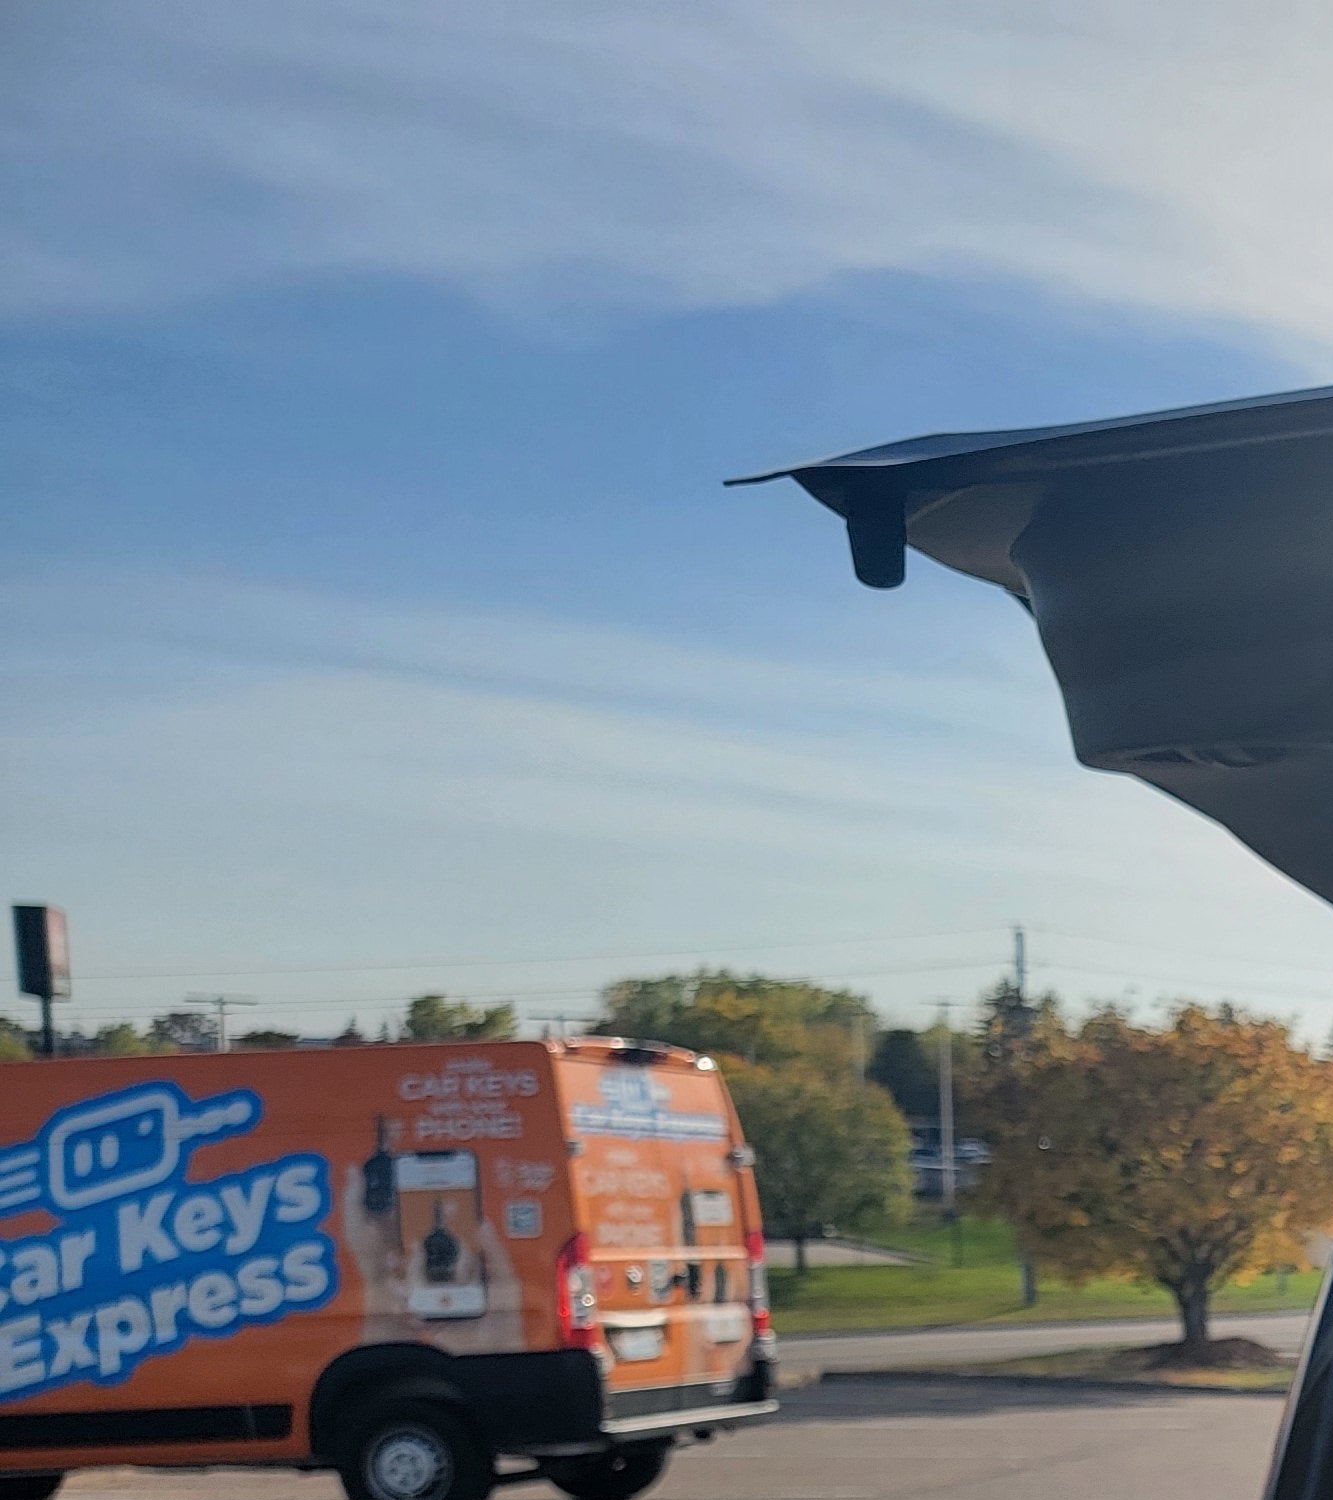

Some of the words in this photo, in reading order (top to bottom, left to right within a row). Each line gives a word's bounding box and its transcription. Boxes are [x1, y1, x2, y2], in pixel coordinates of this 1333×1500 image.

[400, 1073, 460, 1100] CAR
[467, 1069, 539, 1098] KEYS
[116, 1163, 322, 1275] Keys
[0, 1242, 329, 1394] Express
